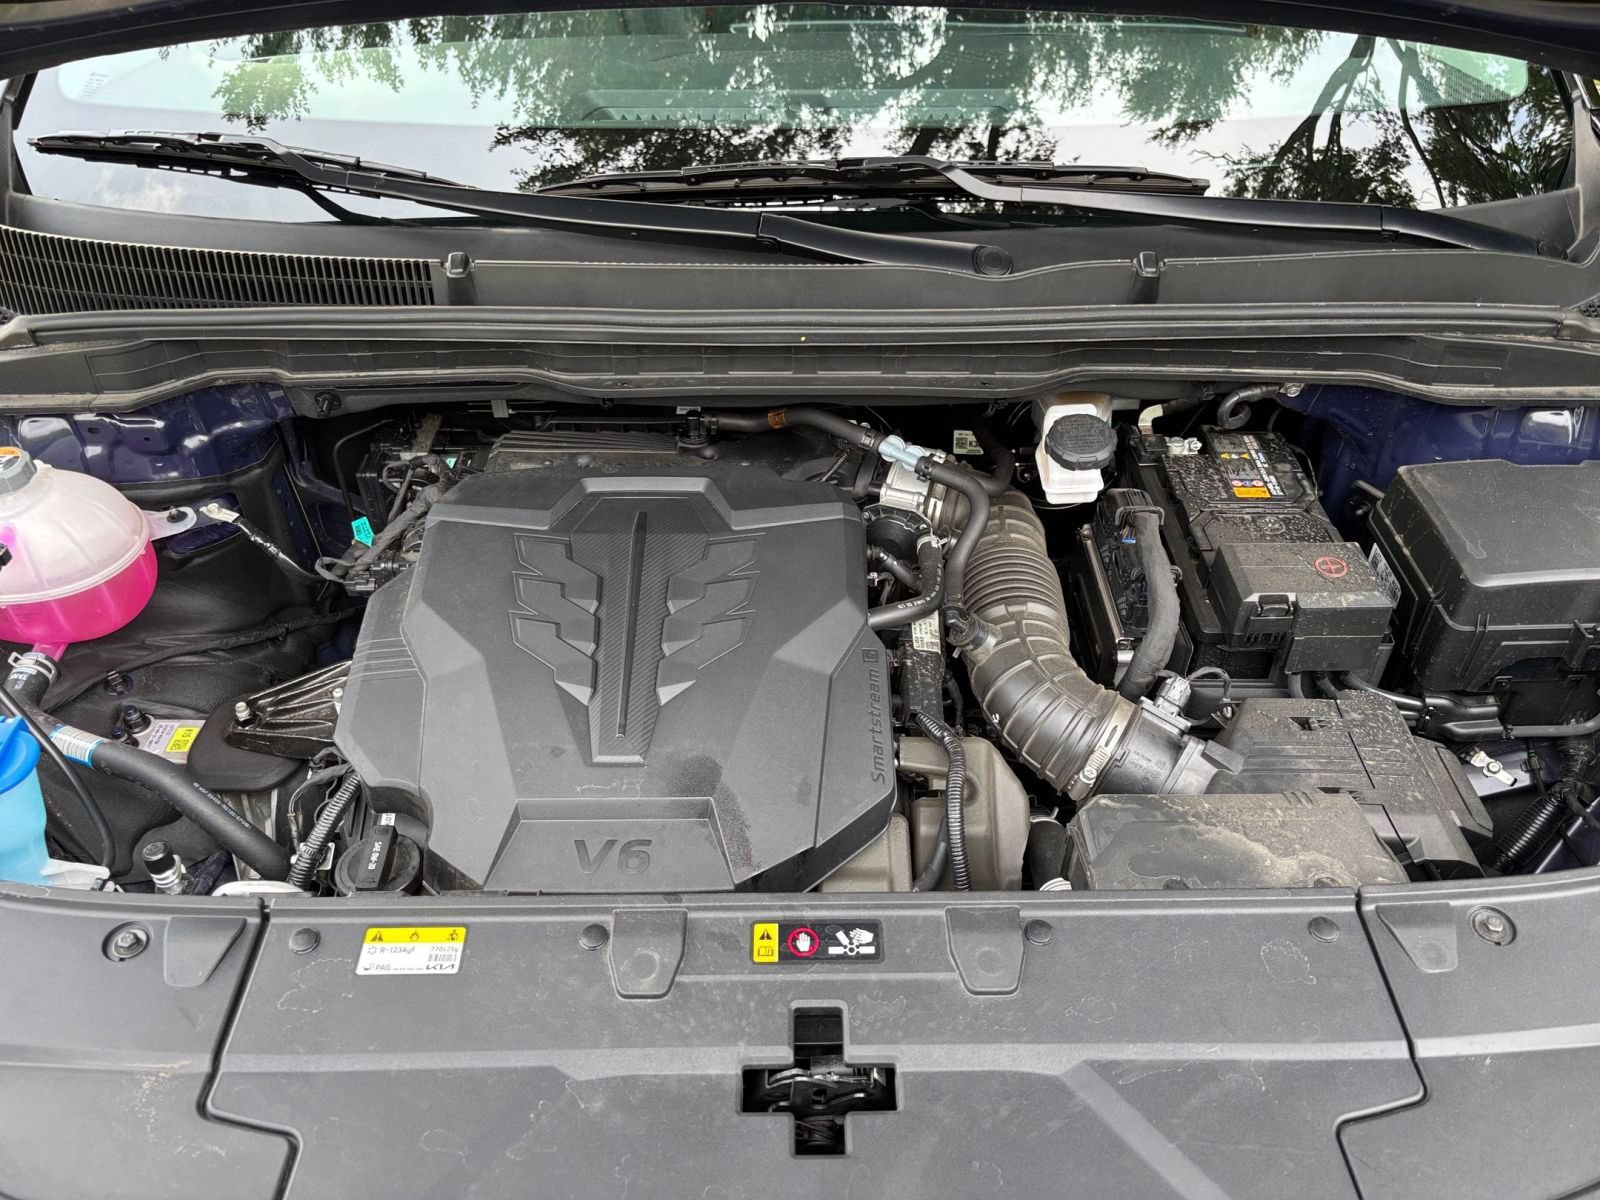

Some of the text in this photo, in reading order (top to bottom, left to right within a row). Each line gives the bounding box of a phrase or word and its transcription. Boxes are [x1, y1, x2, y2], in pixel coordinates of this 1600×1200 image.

[868, 667, 886, 785] Smartstream
[573, 839, 653, 875] V6
[379, 946, 416, 955] R-1234yf
